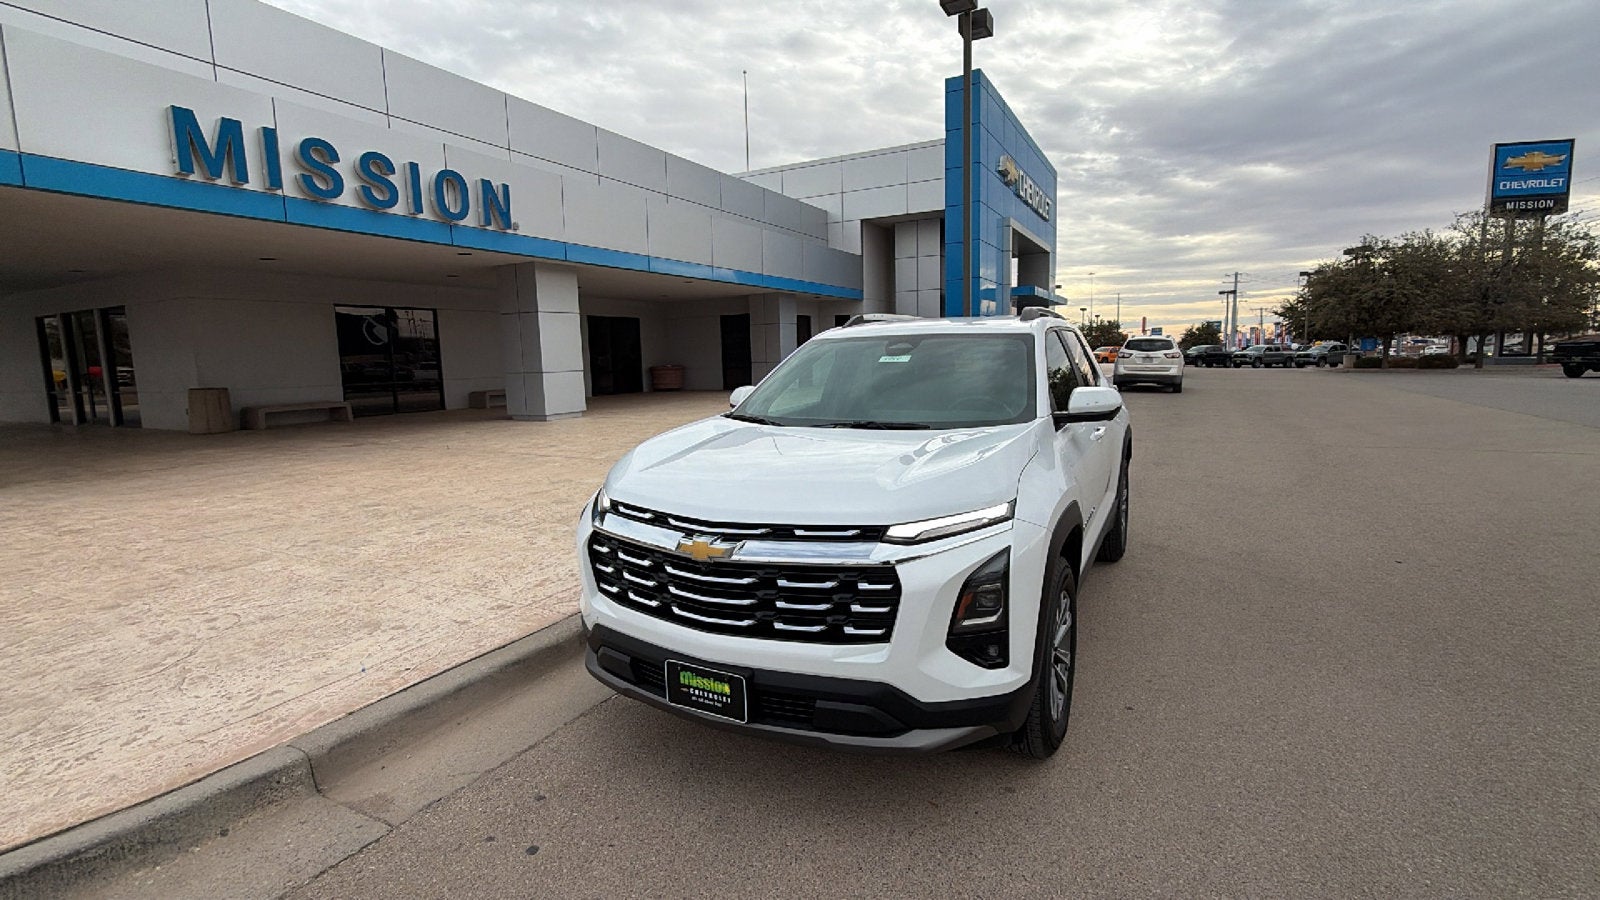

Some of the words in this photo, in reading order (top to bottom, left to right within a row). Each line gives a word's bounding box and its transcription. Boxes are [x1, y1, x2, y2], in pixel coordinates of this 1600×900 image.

[167, 104, 514, 231] MISSION
[1499, 178, 1565, 190] CHEVROLET
[1506, 199, 1554, 210] MISSION
